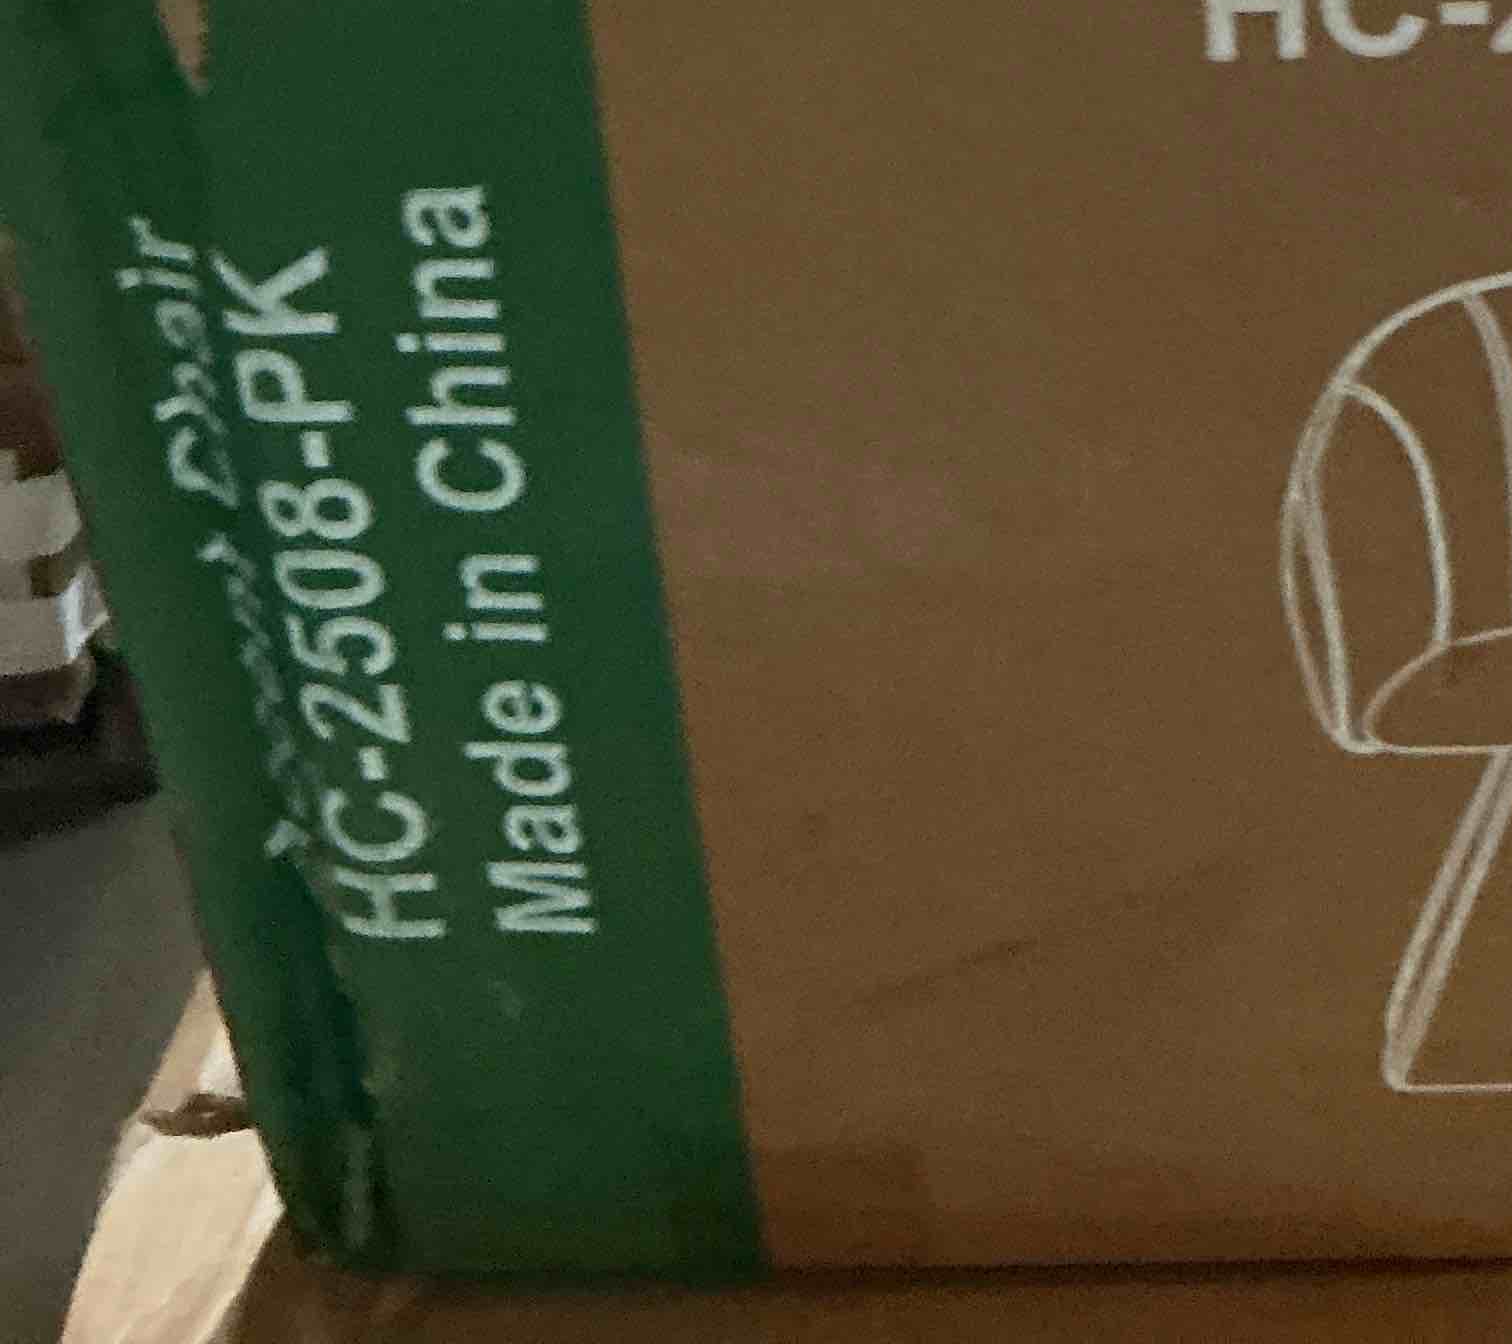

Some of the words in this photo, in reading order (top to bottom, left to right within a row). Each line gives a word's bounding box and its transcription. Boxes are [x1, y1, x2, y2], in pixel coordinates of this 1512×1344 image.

[394, 185, 527, 513] China
[207, 246, 449, 940] HC-2508-PK
[441, 552, 550, 643] in
[461, 678, 599, 935] Made
